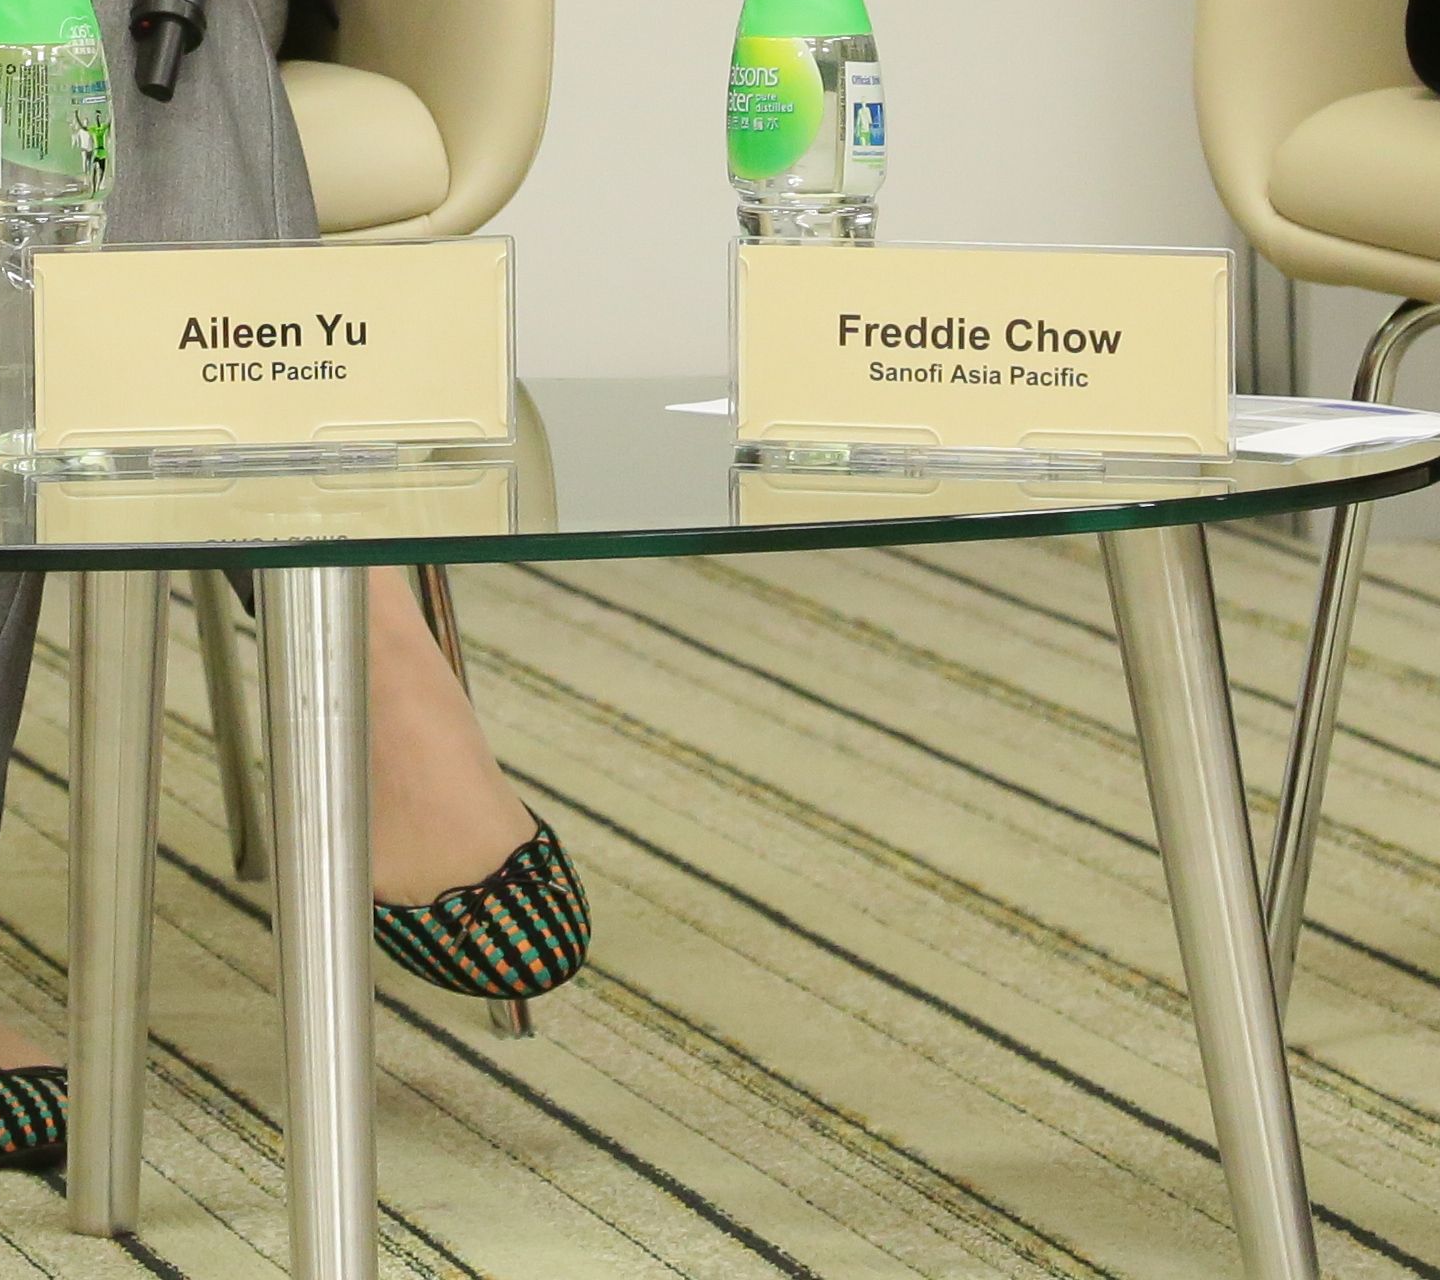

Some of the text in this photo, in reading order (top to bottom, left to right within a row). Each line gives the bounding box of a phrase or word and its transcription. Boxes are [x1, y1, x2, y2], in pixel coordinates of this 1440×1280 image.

[731, 62, 779, 86] atsons
[729, 89, 753, 112] ater
[756, 103, 794, 113] distilled
[178, 313, 369, 351] Aileen Yu
[838, 313, 1123, 355] Freddie Chow
[201, 360, 348, 384] CITIC Pacific
[869, 360, 1089, 389] Sanofi Asia Pacific
